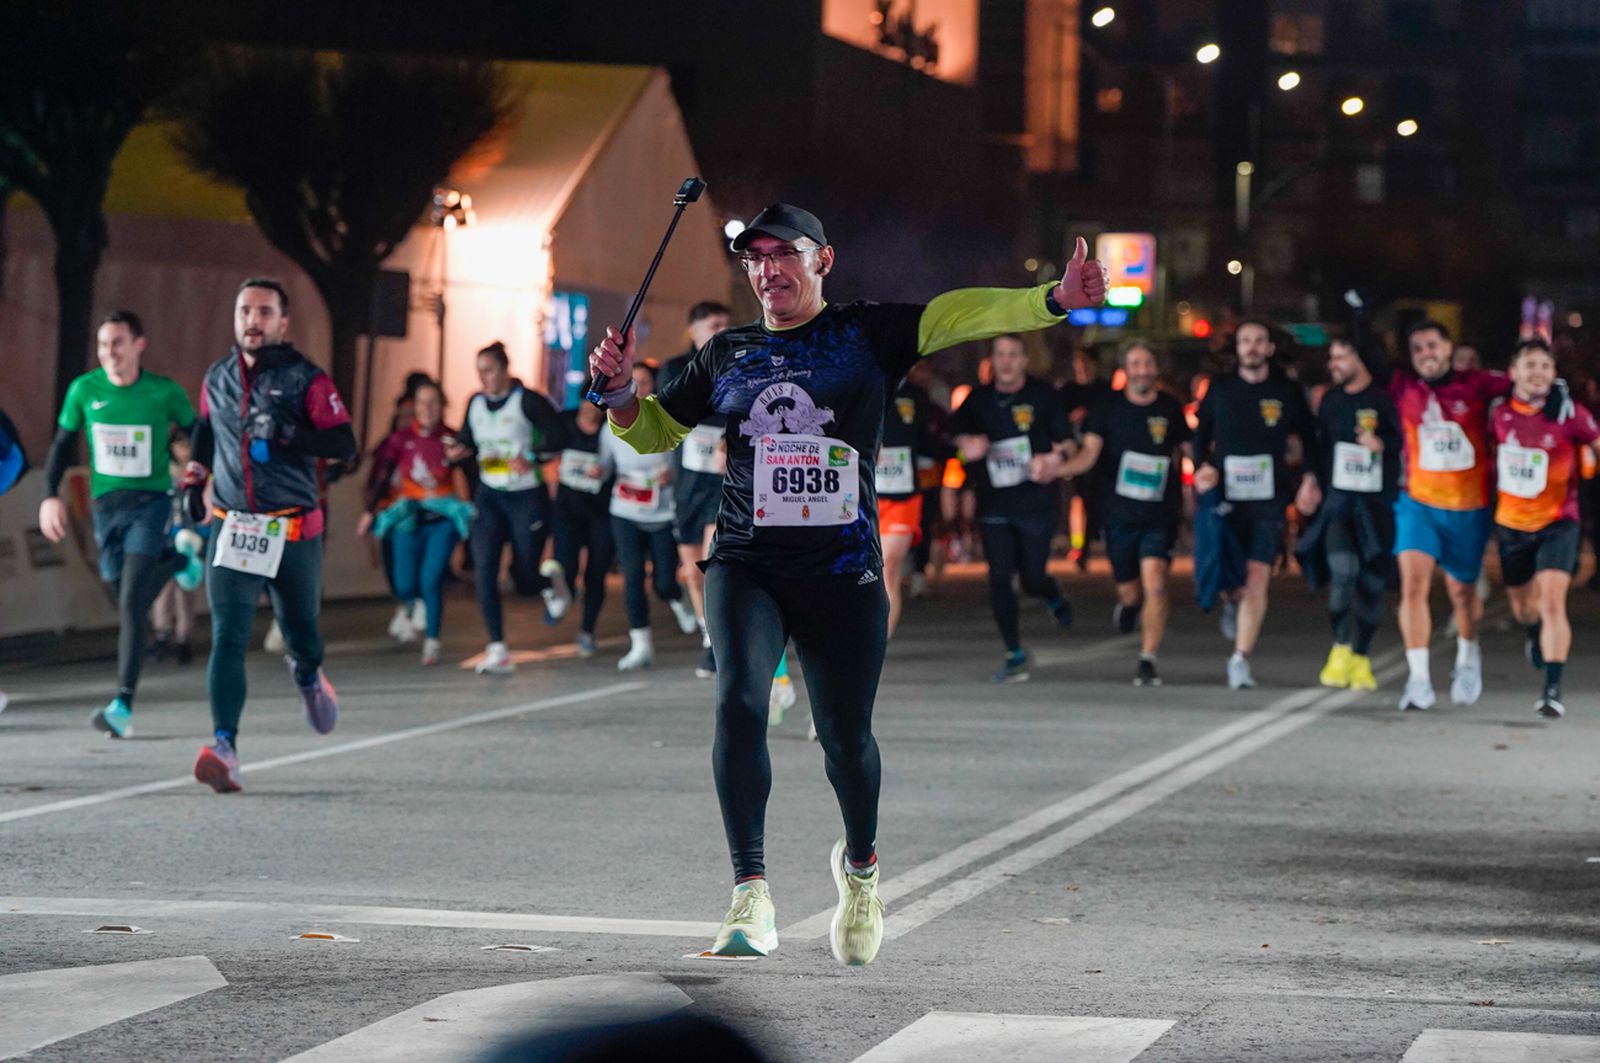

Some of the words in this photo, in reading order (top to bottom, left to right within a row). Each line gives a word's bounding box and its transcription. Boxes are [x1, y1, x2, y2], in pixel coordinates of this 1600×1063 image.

[778, 444, 807, 453] NOCHE
[808, 445, 820, 454] DE
[766, 455, 785, 465] SAN
[772, 467, 840, 494] 6938
[230, 532, 270, 555] 1039
